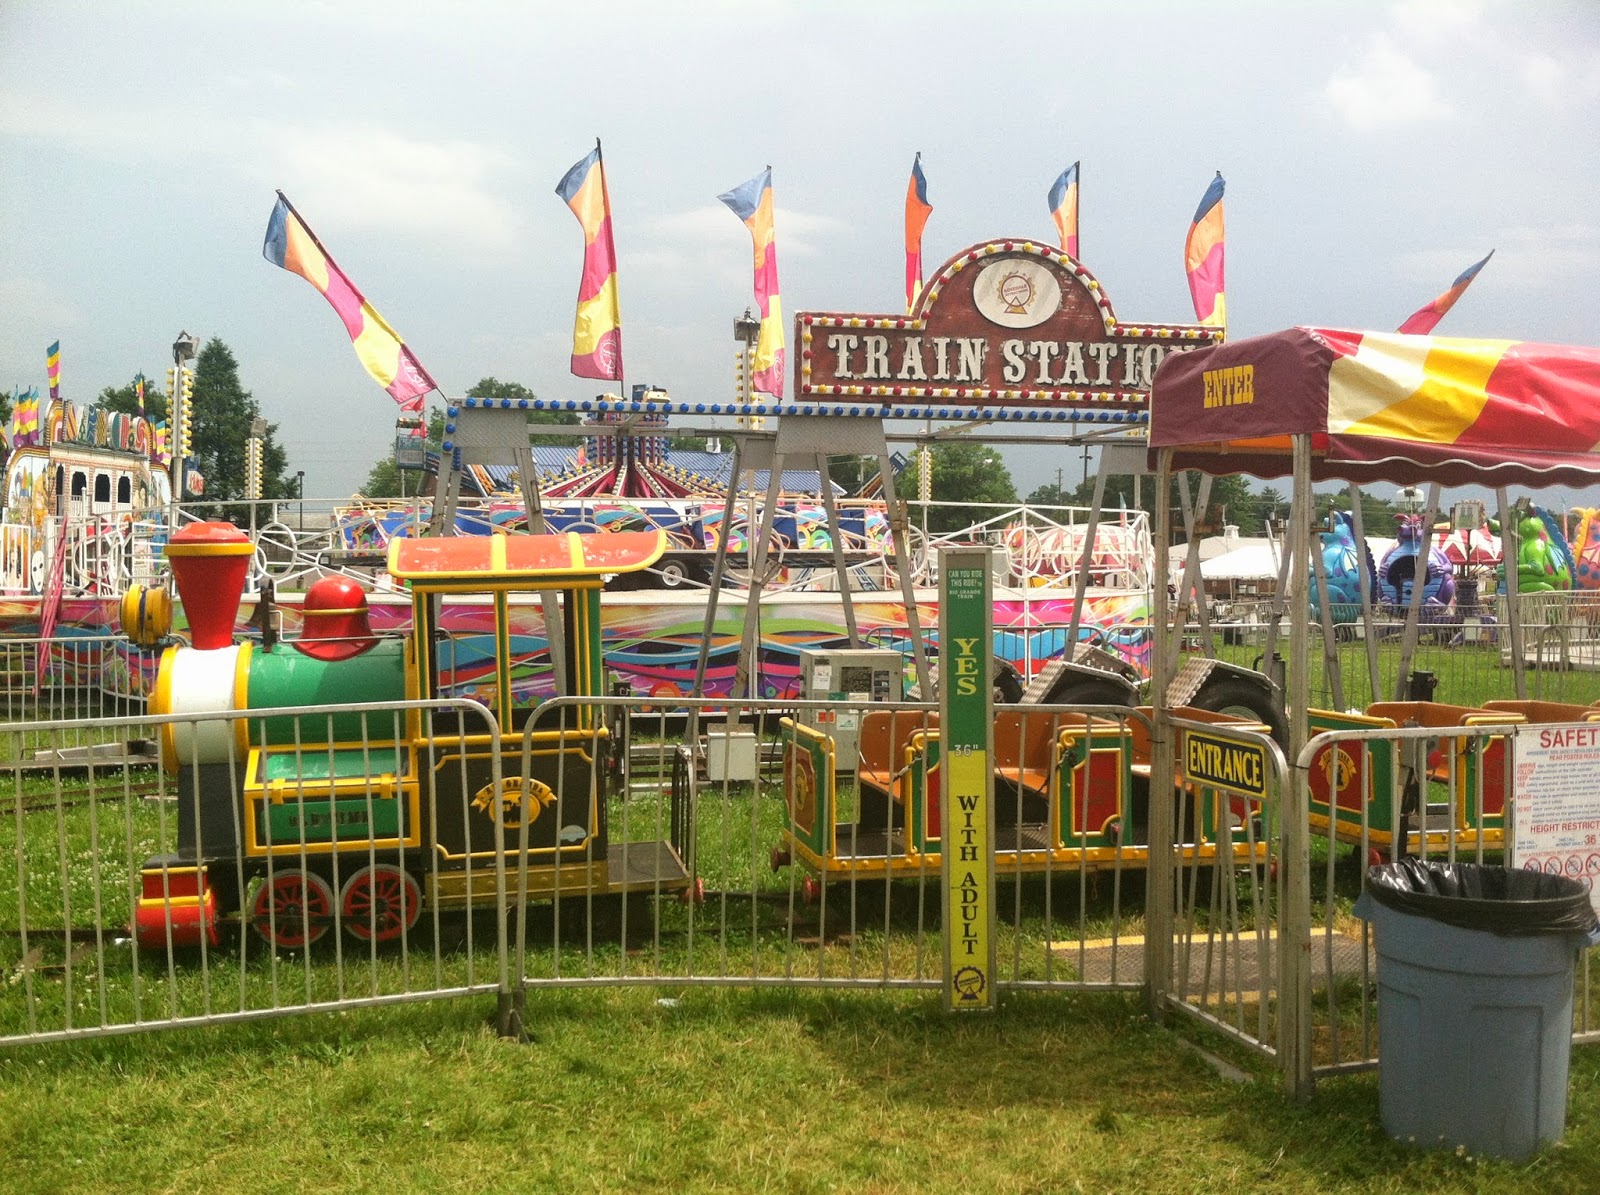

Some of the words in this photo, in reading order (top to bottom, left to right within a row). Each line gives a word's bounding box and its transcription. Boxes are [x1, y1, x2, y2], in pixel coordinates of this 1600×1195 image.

[827, 334, 986, 383] TRAIN
[1003, 338, 1196, 388] STATIO
[1203, 364, 1254, 409] ENTER
[949, 570, 959, 578] CAN
[960, 570, 971, 578] YOU
[971, 570, 983, 578] RIDE
[951, 579, 962, 587] THIS
[953, 638, 979, 696] YES
[954, 744, 979, 757] 36"
[1540, 729, 1600, 748] SAFET
[1189, 740, 1262, 788] ENTRANCE
[957, 795, 980, 861] WITH
[1531, 824, 1560, 834] HEIGHT
[1562, 821, 1600, 831] RESTRICT
[1584, 834, 1597, 845] 36
[960, 872, 979, 955] ADULT
